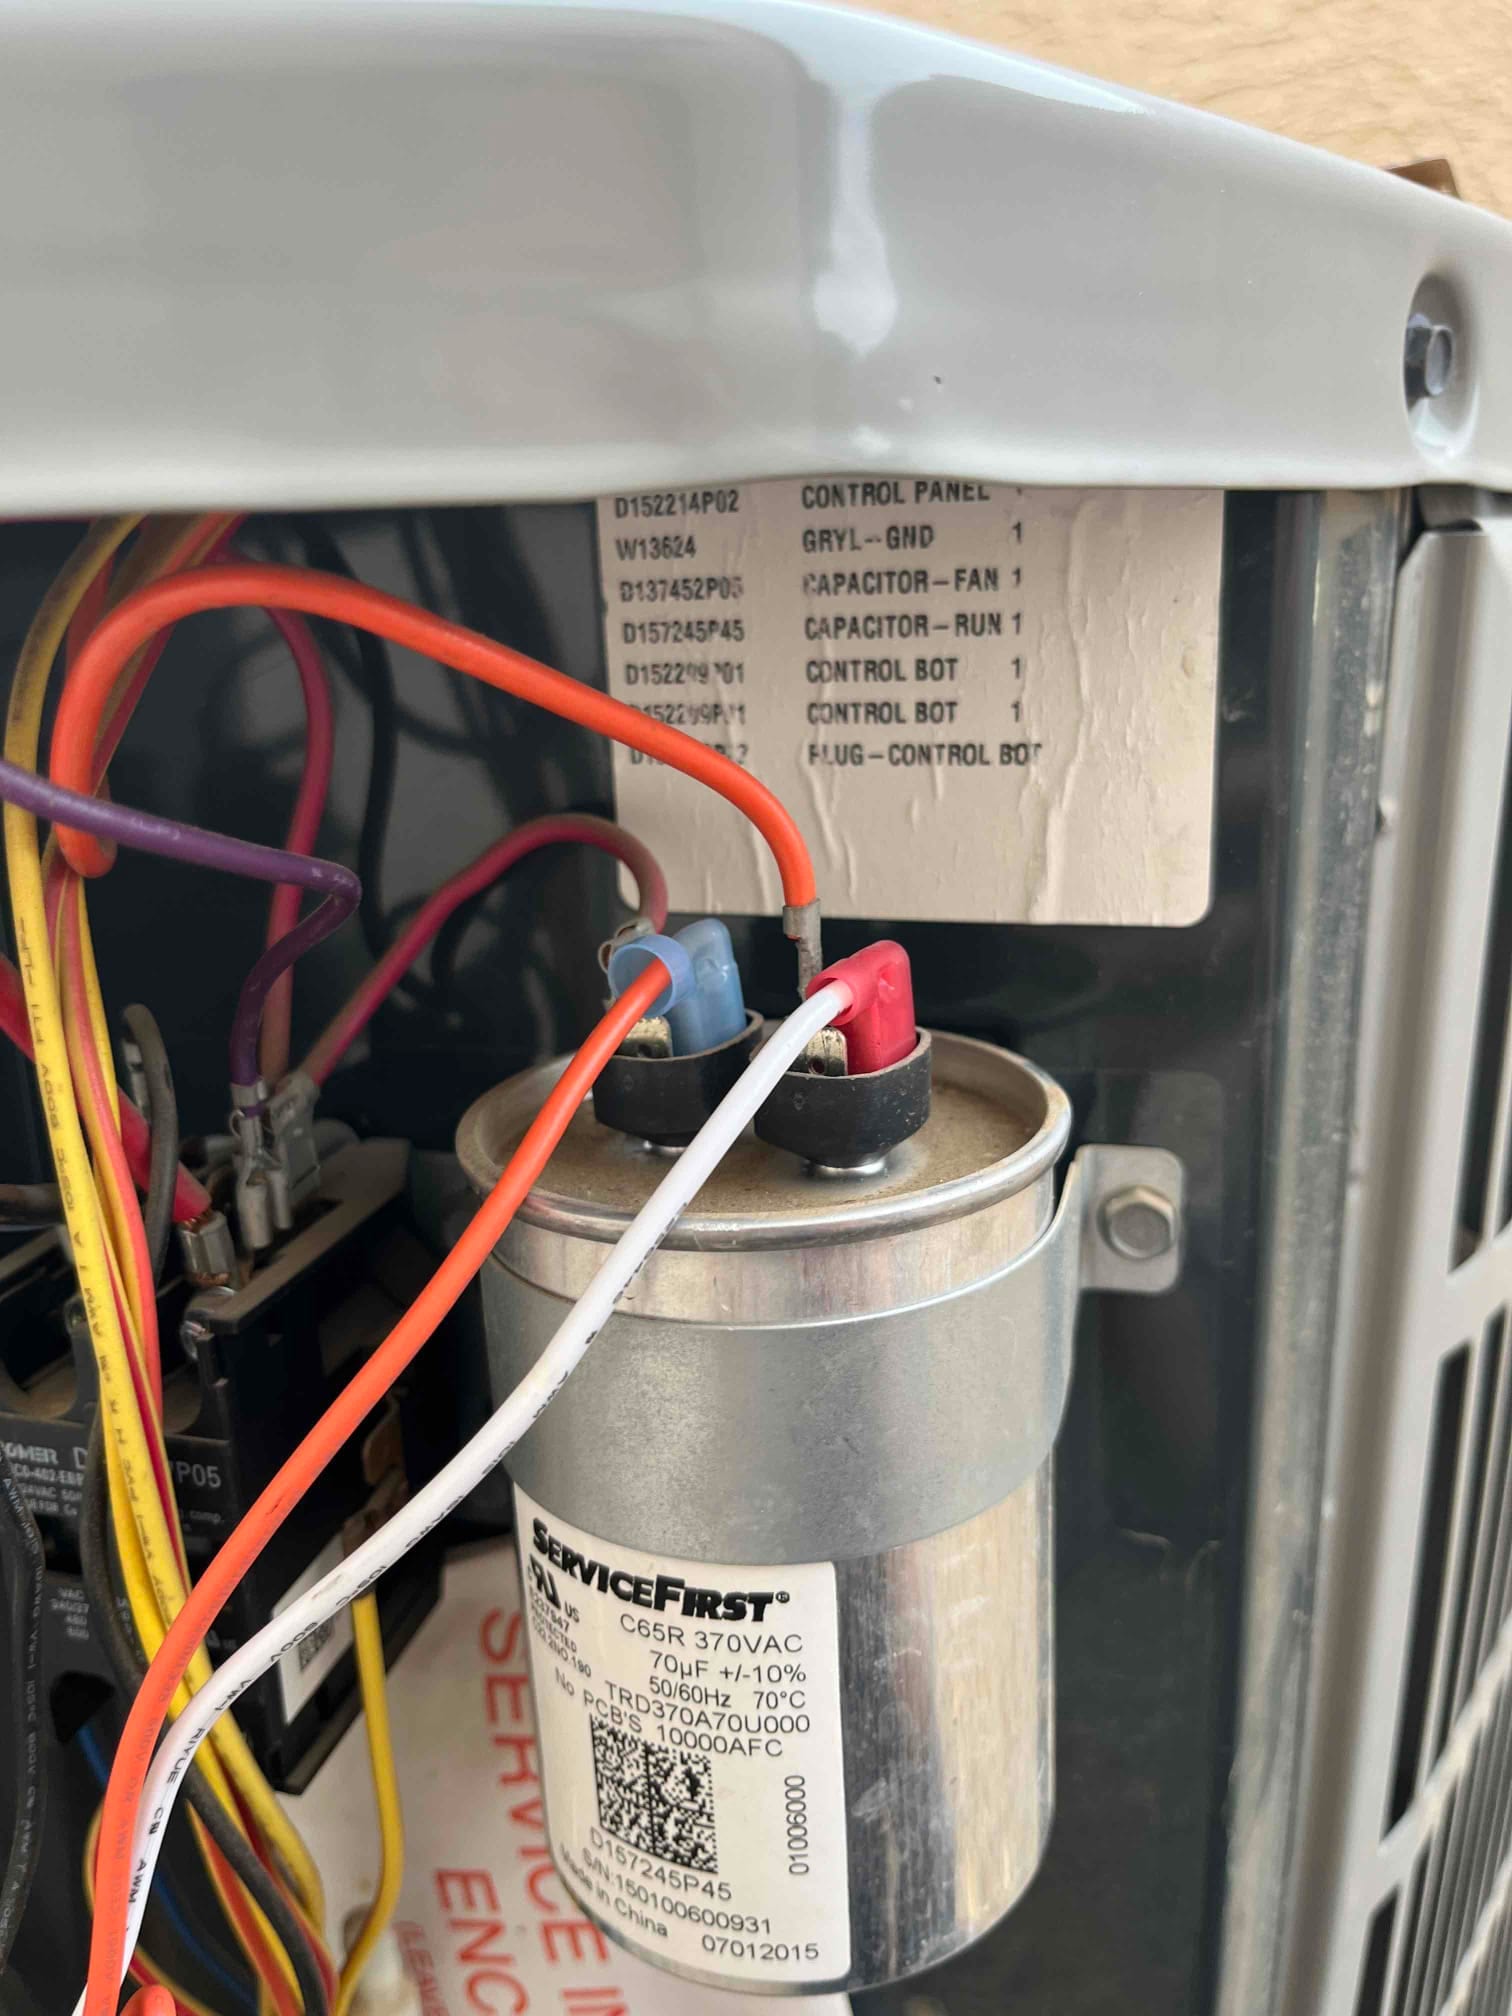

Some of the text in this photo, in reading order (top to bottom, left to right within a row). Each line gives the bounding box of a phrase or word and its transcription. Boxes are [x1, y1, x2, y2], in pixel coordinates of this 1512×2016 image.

[615, 480, 991, 519] D152214P02 CONTROL PANEL
[615, 535, 697, 562] W13624
[1012, 521, 1023, 544] 1
[1012, 568, 1022, 589] 1
[622, 618, 746, 646] D157245P45
[1011, 612, 1022, 636] 1
[805, 658, 907, 684] CONTROL
[914, 657, 959, 682] BOT
[1010, 657, 1021, 681] 1
[806, 702, 907, 726] CONTROL
[914, 701, 958, 723] BOT
[1011, 700, 1021, 723] 1
[619, 1612, 804, 1655] C65R 370VAC
[649, 1676, 806, 1710] 50/60Hz 70°C
[719, 1663, 807, 1685] +/-10%
[554, 1667, 783, 1758] No PCB'S 10000AFC
[604, 1680, 811, 1734] TRD370A70U000
[784, 1774, 810, 1876] 01006000
[127, 1858, 147, 1903] AWM
[590, 1826, 732, 1902] D157245P45
[596, 1883, 611, 1906] in
[615, 1892, 669, 1938] China
[701, 1934, 820, 1962] 07012015
